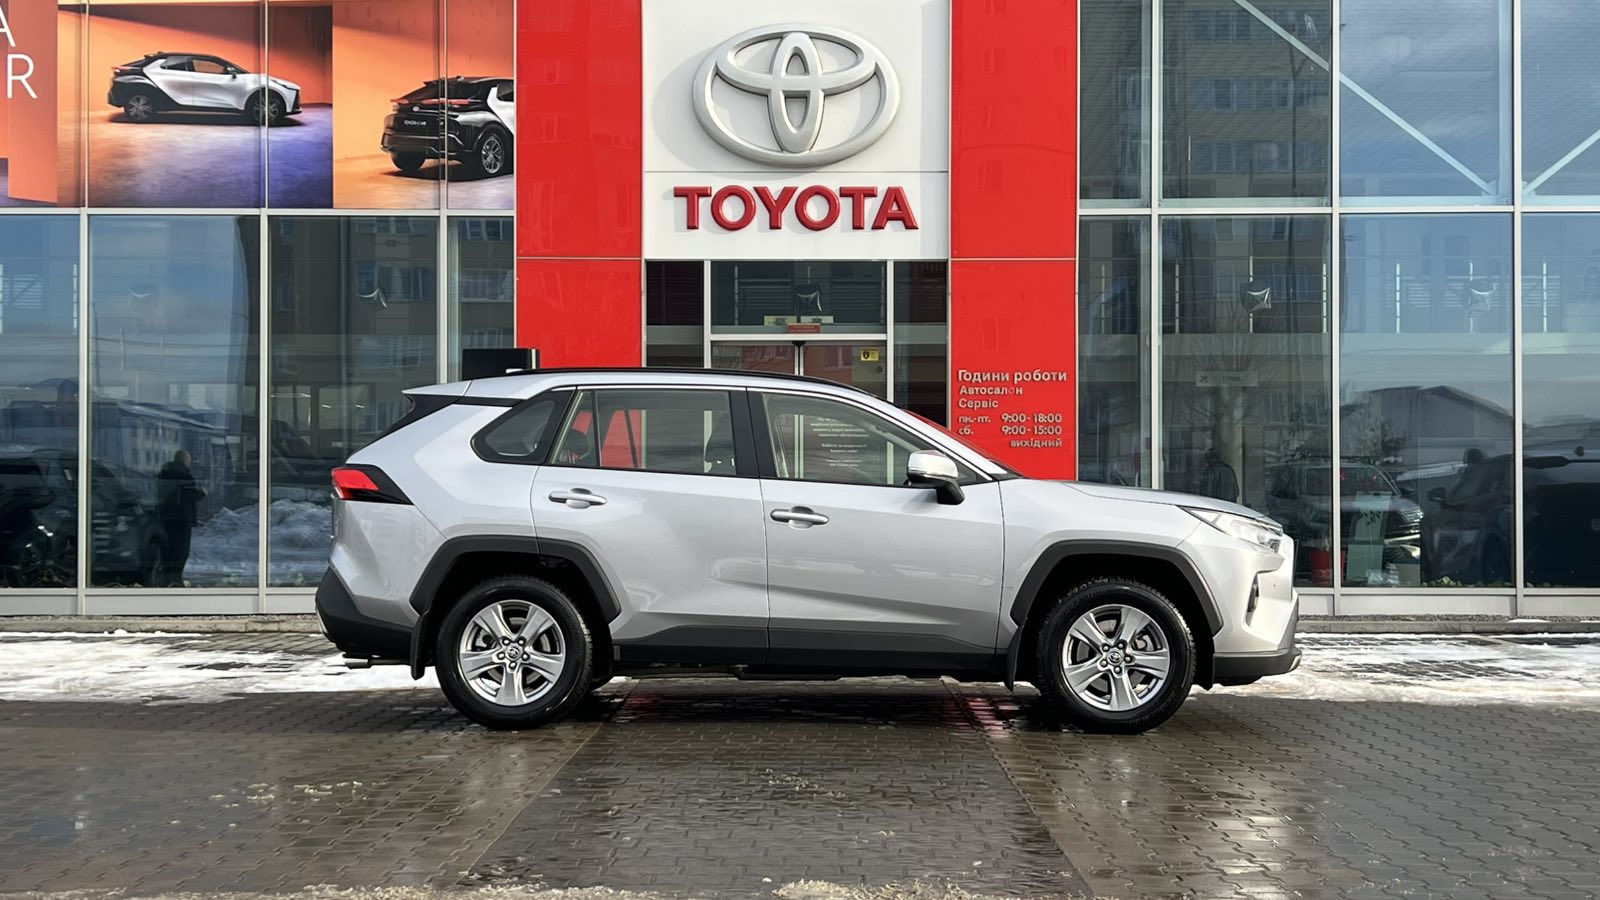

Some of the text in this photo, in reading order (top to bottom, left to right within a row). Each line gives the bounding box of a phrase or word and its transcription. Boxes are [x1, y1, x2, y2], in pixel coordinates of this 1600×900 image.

[673, 185, 919, 231] TOYOTA
[958, 369, 1067, 384] Години роботи
[959, 385, 1023, 395] Автосалон
[958, 398, 999, 410] Сервіс
[958, 424, 974, 435] сб.
[1010, 438, 1063, 448] вихідний
